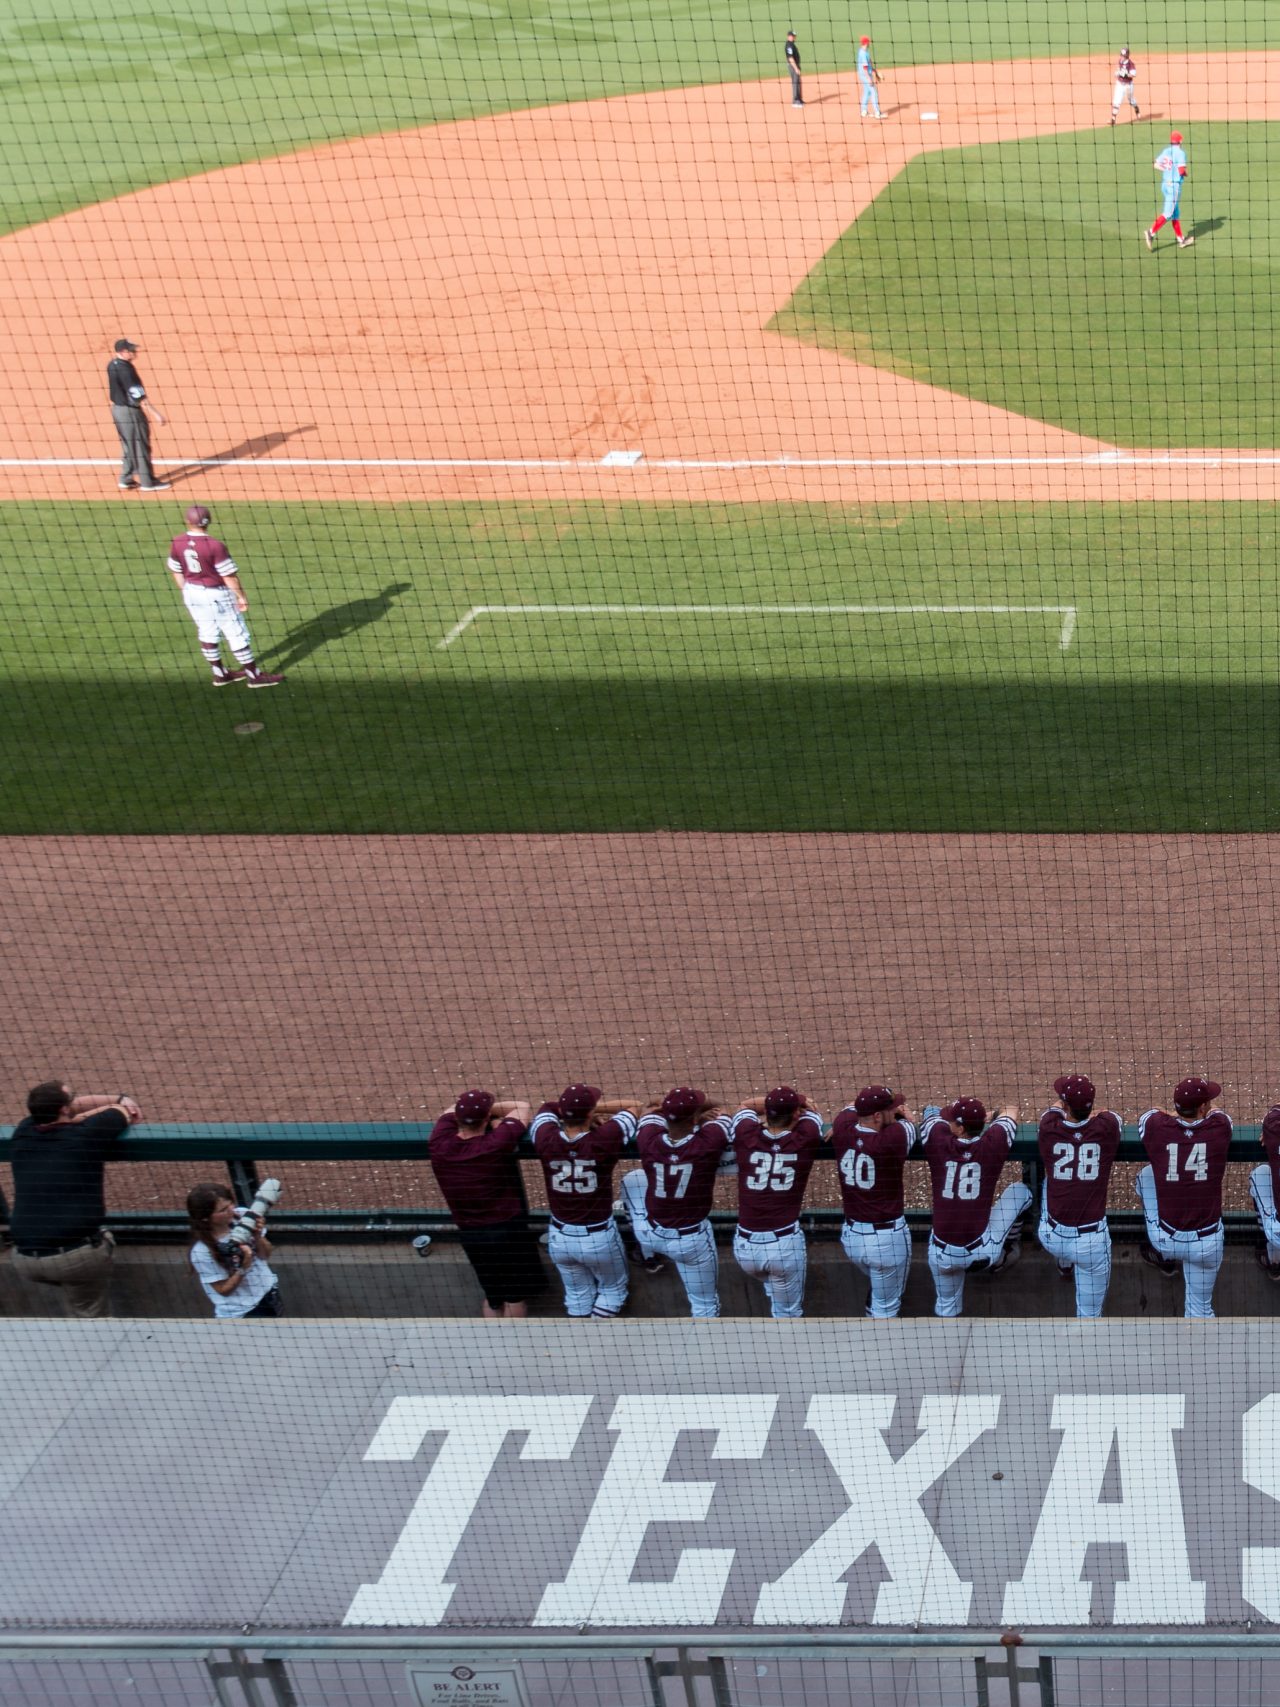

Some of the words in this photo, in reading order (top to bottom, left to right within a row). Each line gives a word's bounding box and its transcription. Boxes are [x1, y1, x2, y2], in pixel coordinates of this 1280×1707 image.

[184, 549, 202, 573] 6
[549, 1159, 598, 1193] 25
[653, 1162, 694, 1199] 17
[749, 1152, 799, 1191] 35
[840, 1148, 876, 1190] 40
[942, 1160, 982, 1200] 18
[1053, 1142, 1101, 1181] 28
[1166, 1143, 1208, 1182] 14
[433, 1683, 452, 1691] BE
[456, 1683, 502, 1691] ALERT
